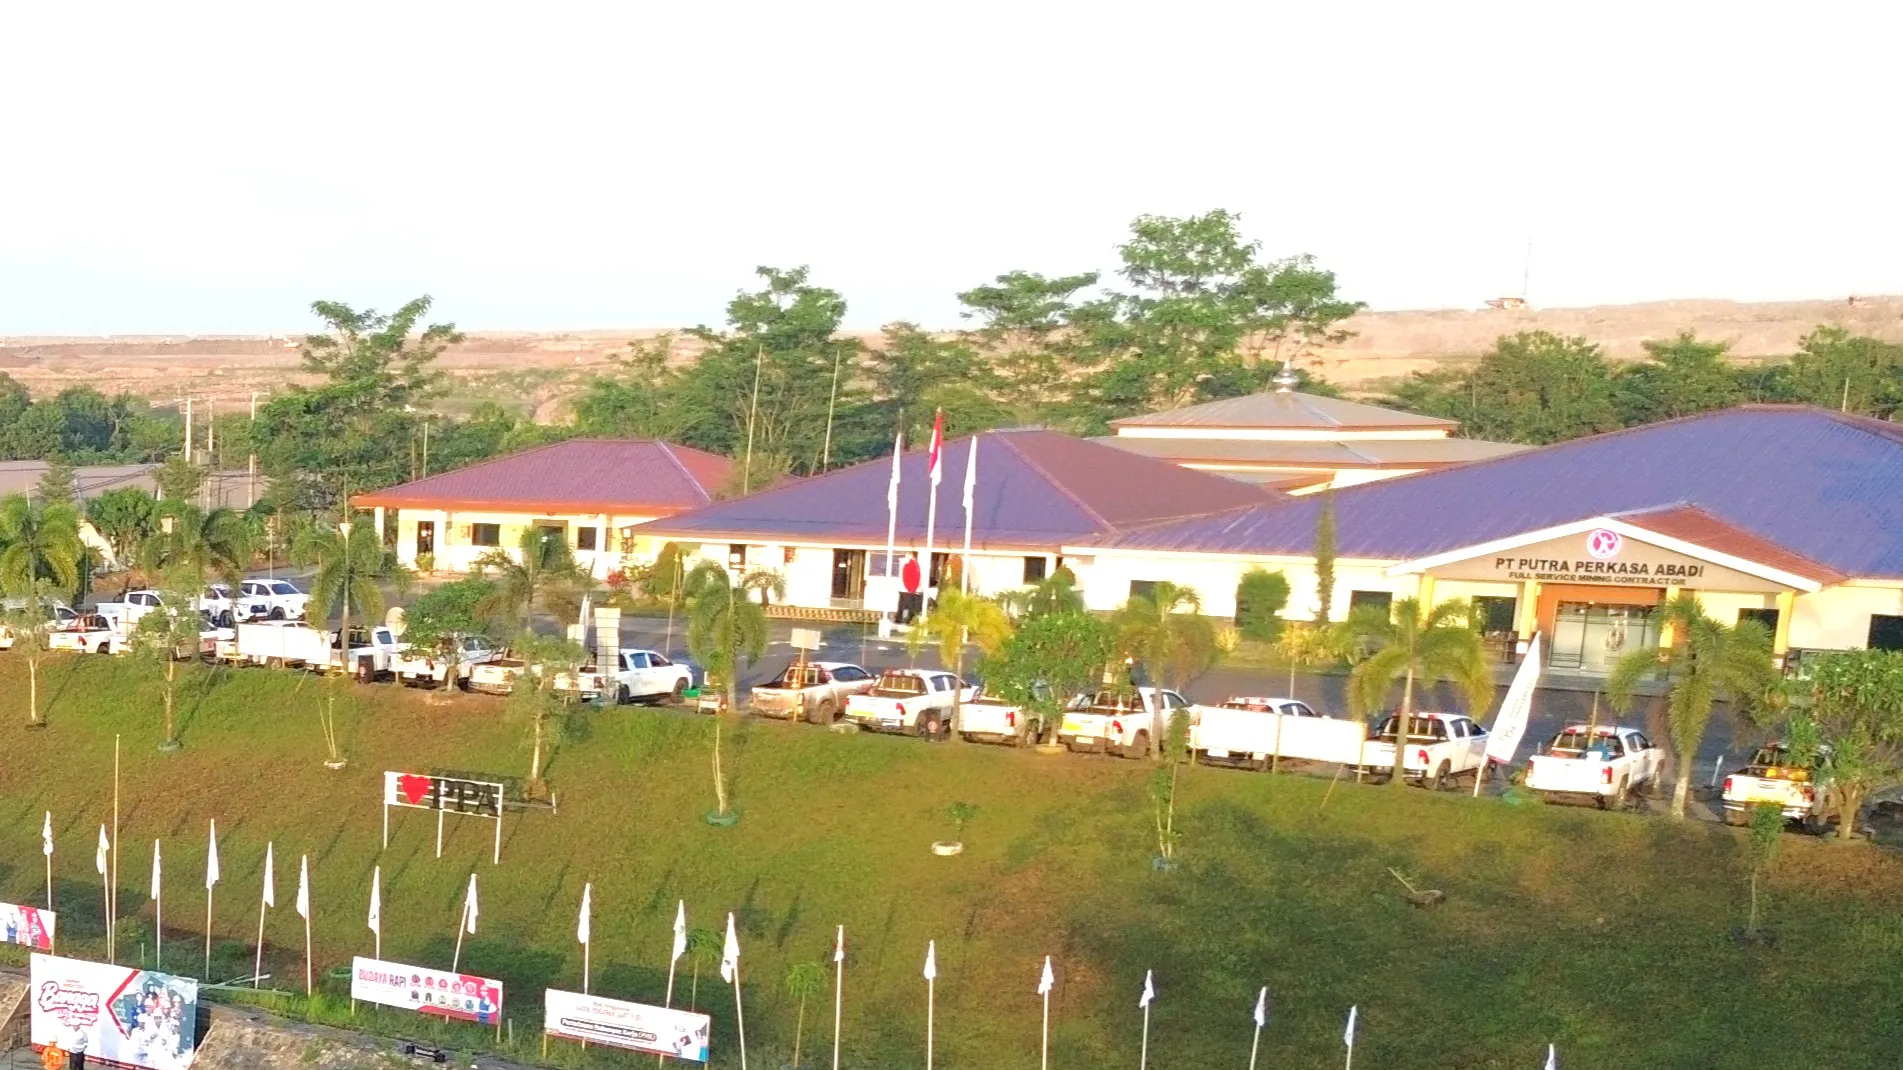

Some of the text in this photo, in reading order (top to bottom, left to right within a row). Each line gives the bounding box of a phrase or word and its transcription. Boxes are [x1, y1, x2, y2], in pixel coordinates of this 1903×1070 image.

[1495, 558, 1705, 577] PT PUTRA PERKASA ABADI
[1535, 573, 1577, 582] SERVICE
[1578, 575, 1612, 583] MINING
[1614, 576, 1686, 586] CONTRACTOR
[429, 778, 500, 817] PPA
[38, 981, 99, 1013] Bangga
